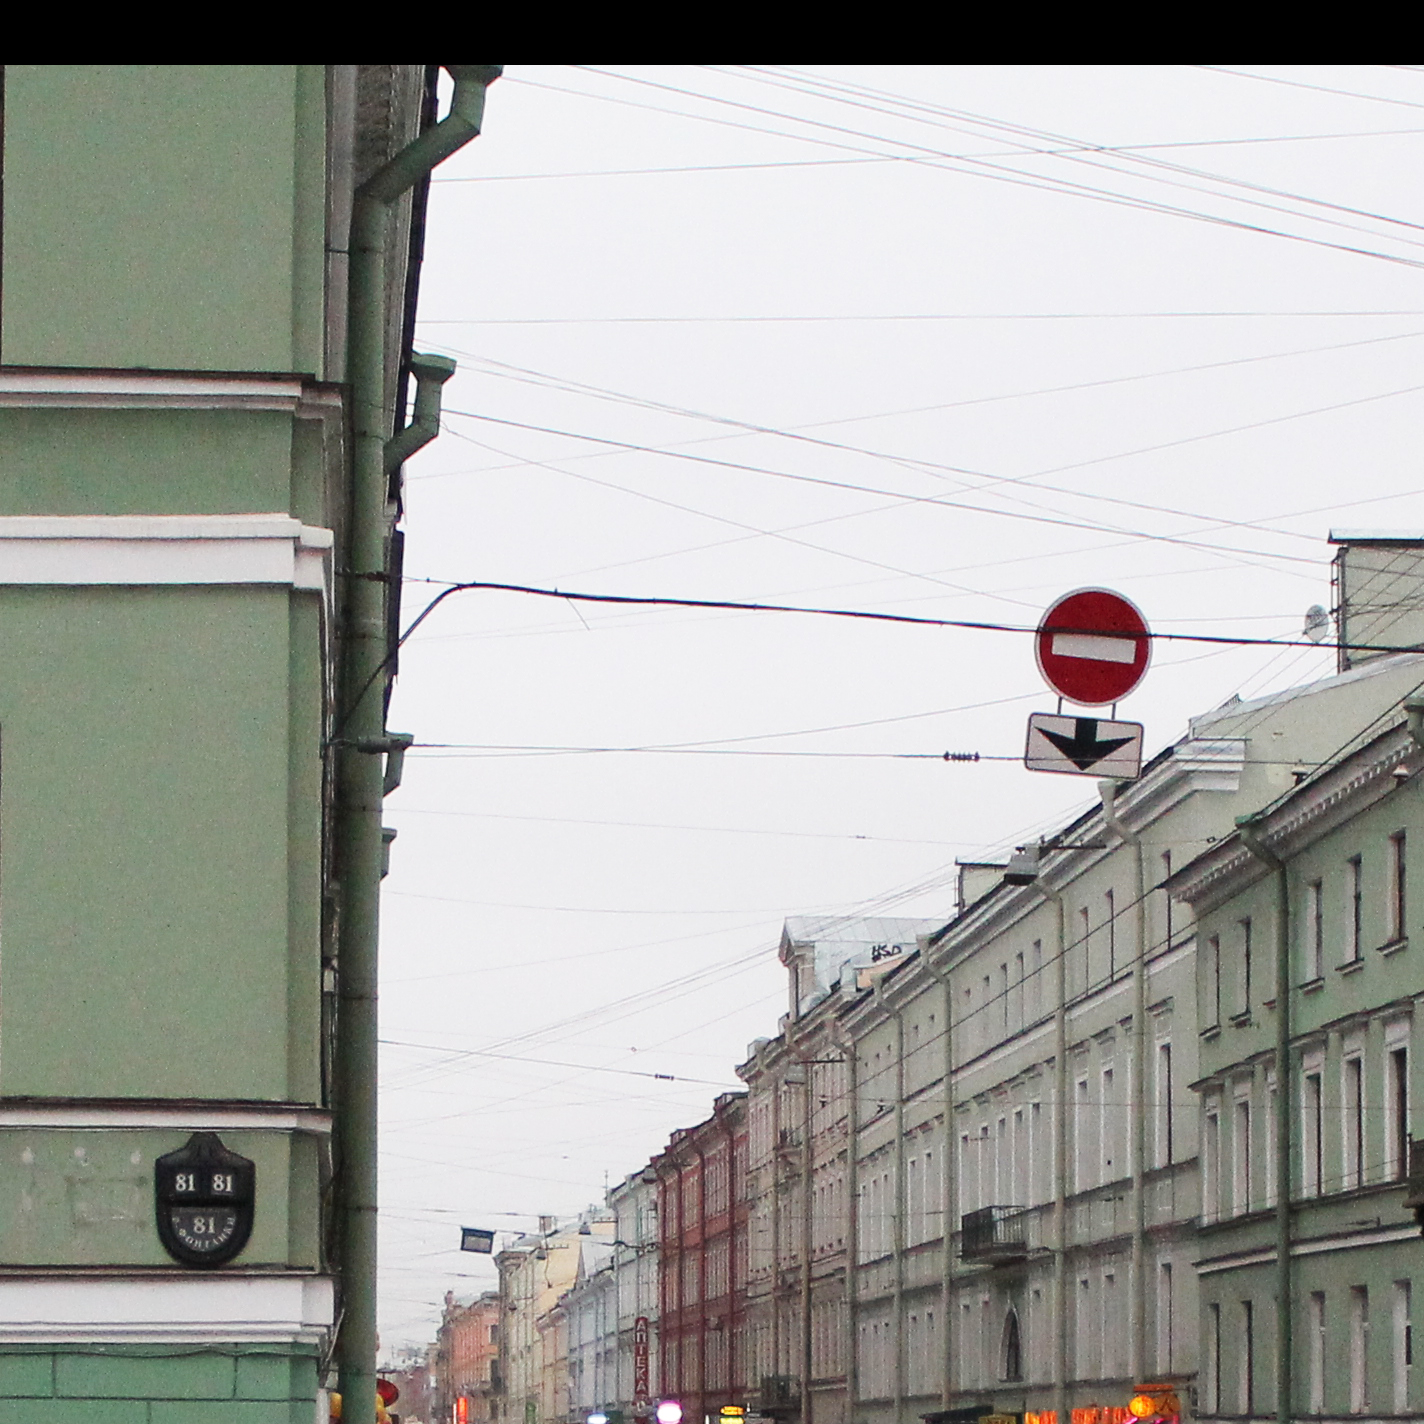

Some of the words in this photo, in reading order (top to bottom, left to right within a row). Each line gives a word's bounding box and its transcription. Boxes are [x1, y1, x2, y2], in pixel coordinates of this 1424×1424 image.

[175, 1173, 196, 1192] 81
[212, 1173, 234, 1193] 81
[193, 1216, 216, 1234] 81
[635, 1320, 647, 1392] АПТЕКА
